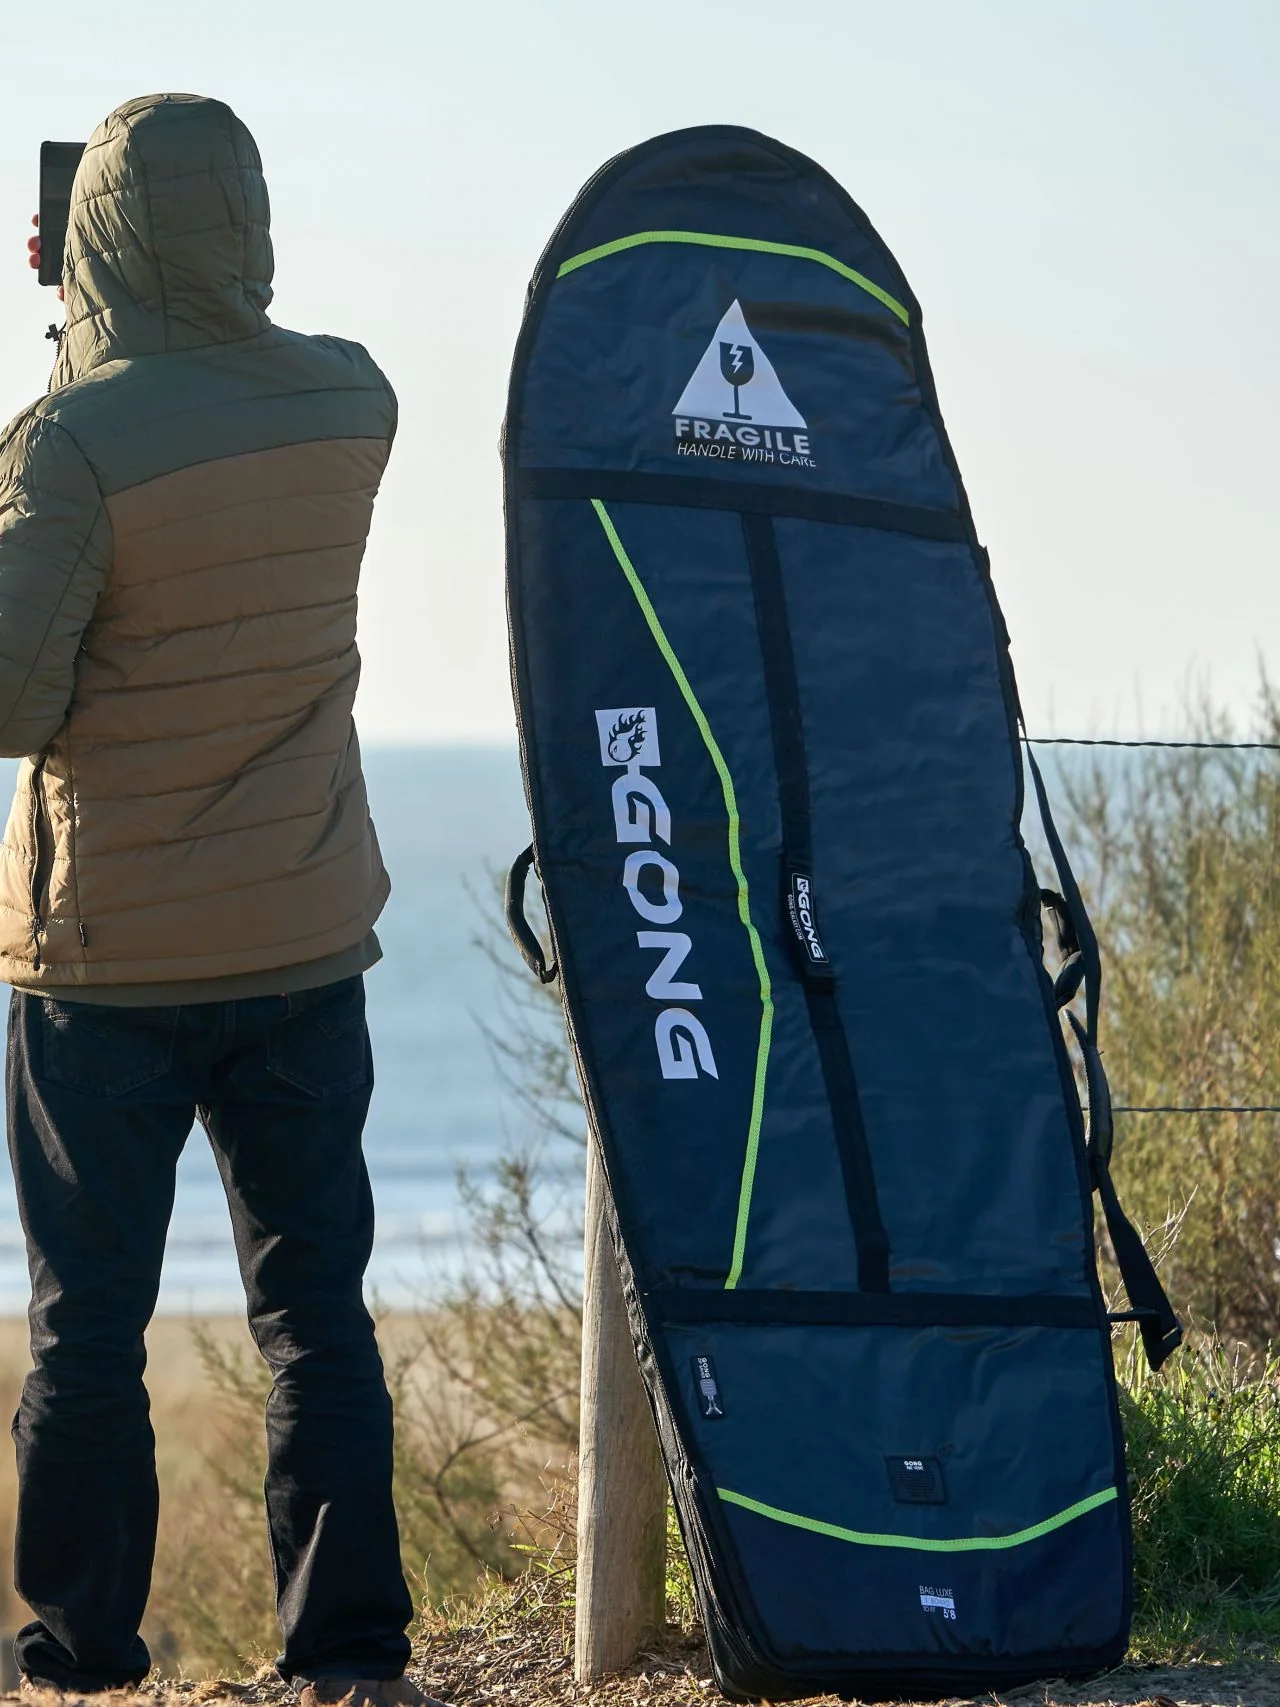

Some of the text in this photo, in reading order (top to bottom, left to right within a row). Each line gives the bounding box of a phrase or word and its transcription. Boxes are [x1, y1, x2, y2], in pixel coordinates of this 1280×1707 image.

[675, 418, 811, 455] FRAGILE
[677, 442, 817, 468] HANDLE WITH CARE
[612, 773, 719, 1080] GONG
[798, 892, 825, 959] GONG
[919, 1585, 954, 1598] BAG LUXE
